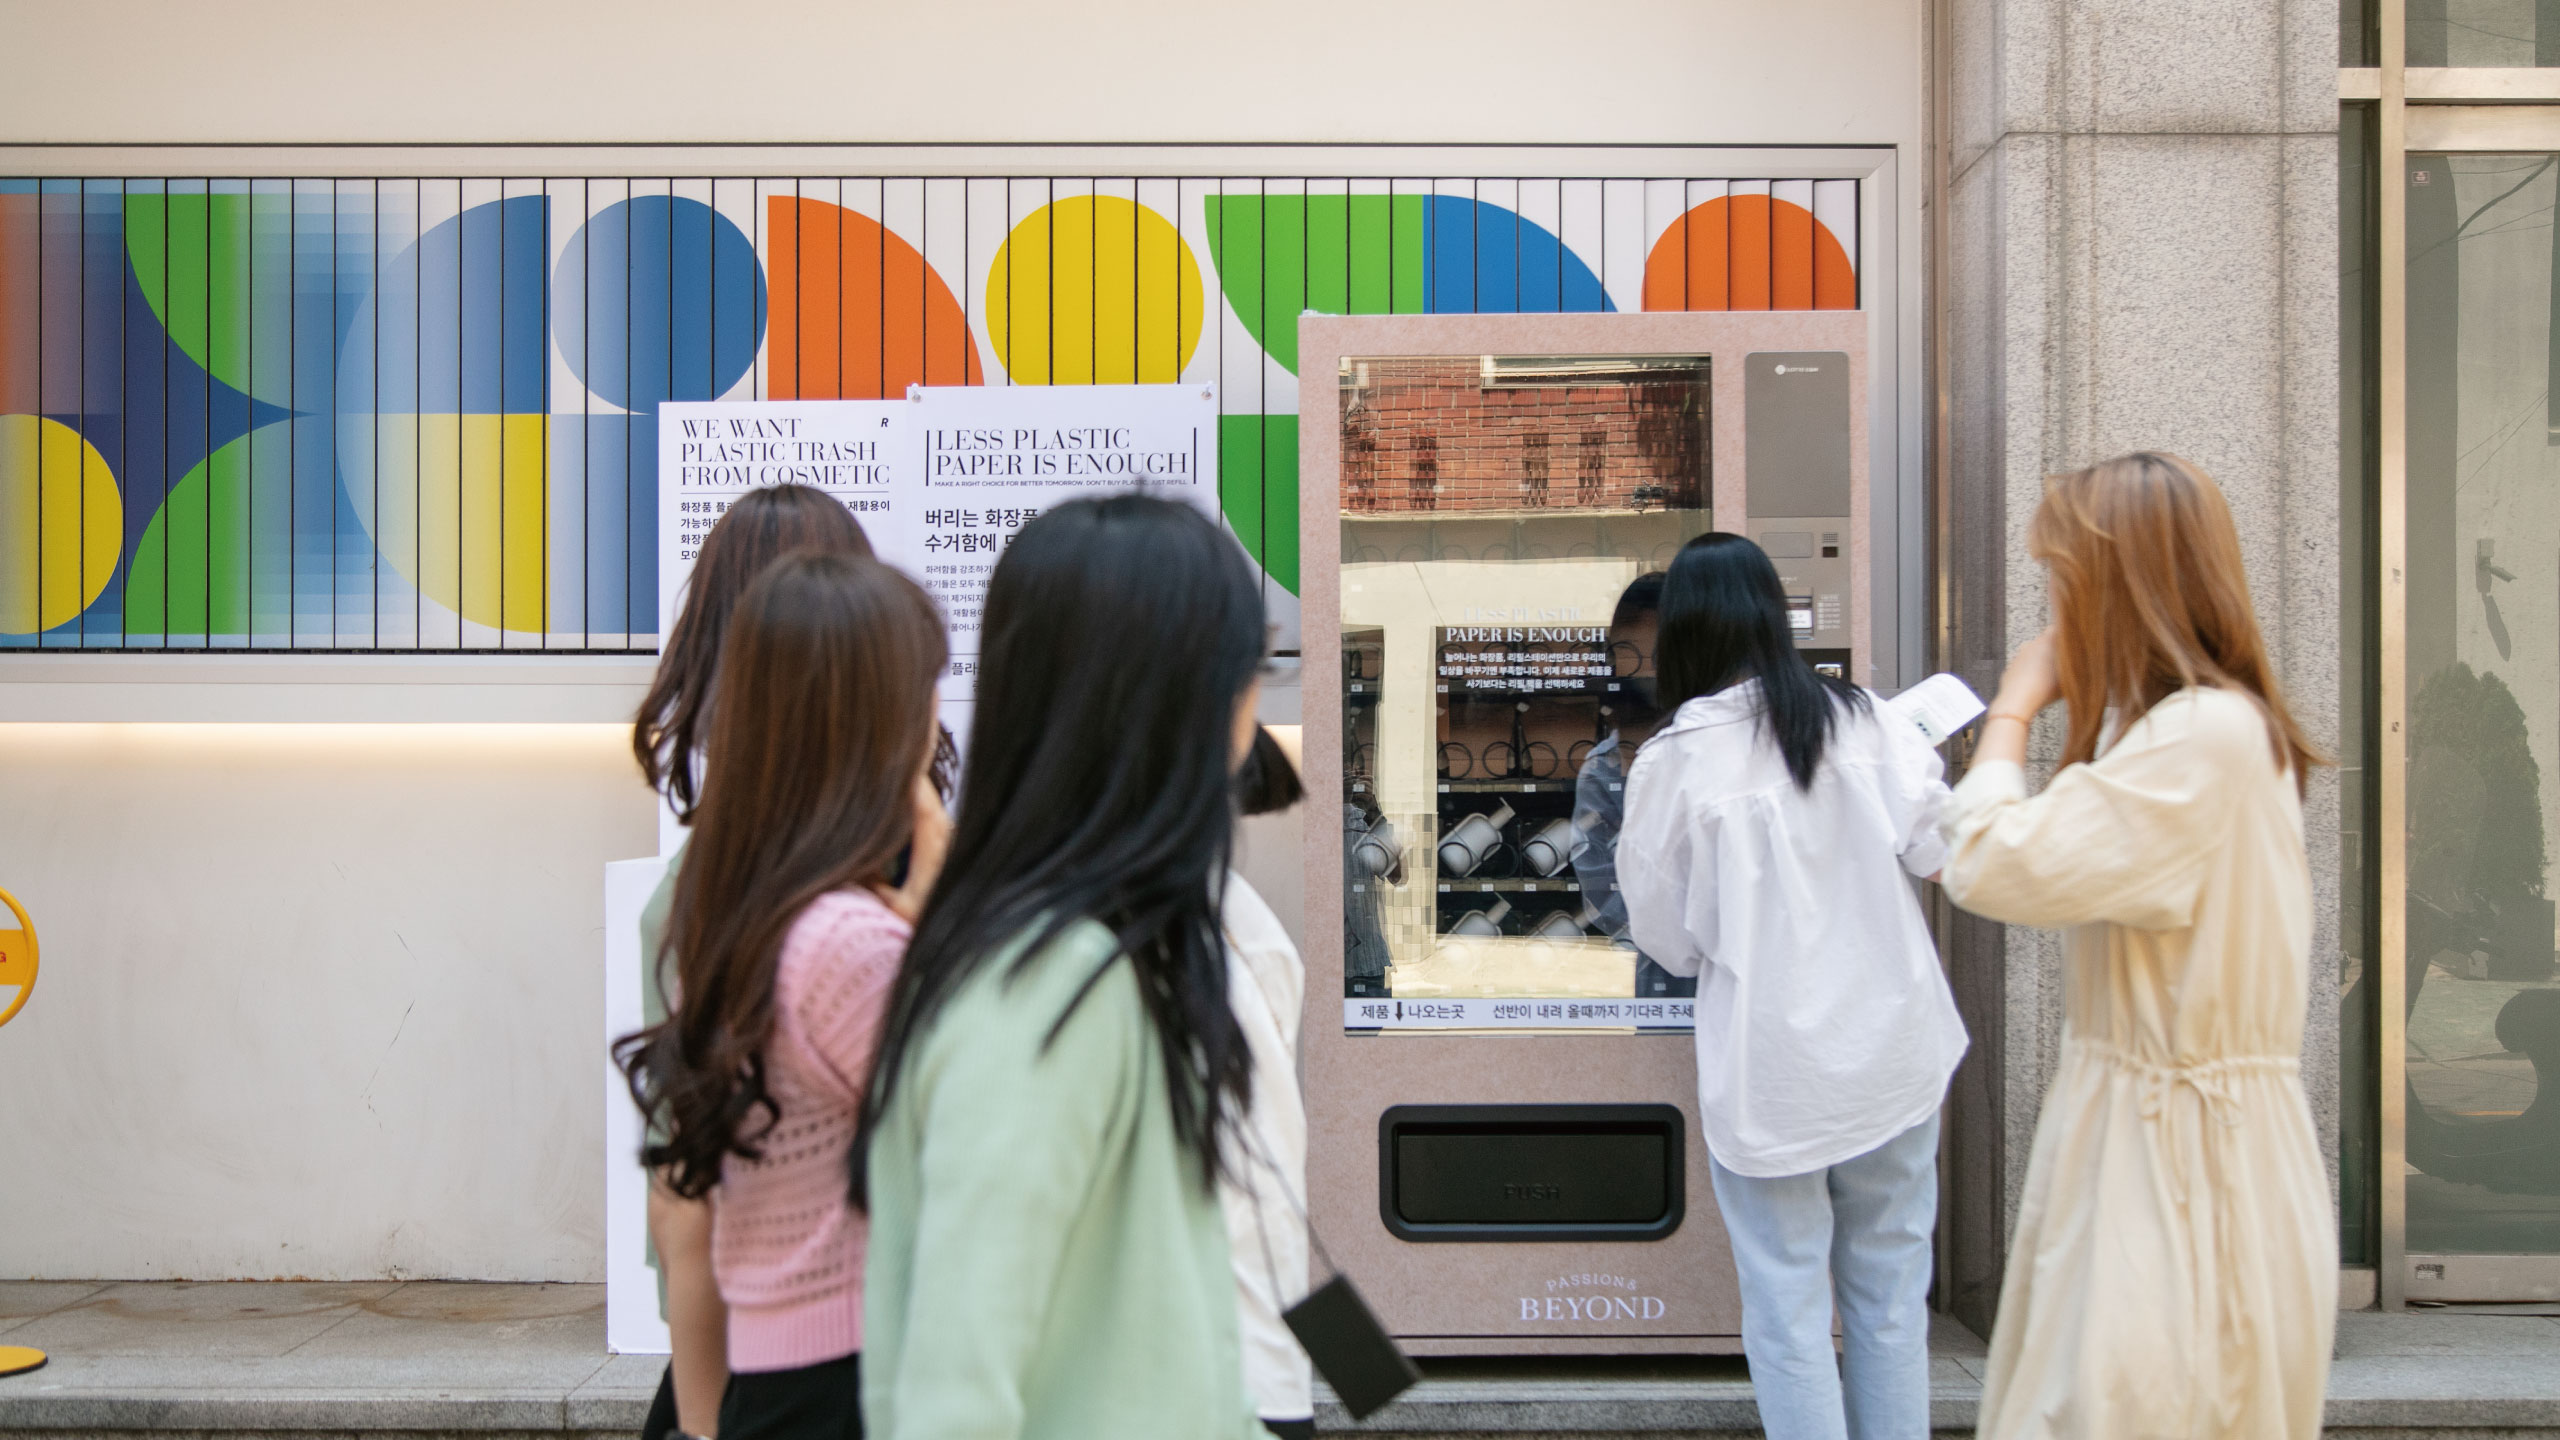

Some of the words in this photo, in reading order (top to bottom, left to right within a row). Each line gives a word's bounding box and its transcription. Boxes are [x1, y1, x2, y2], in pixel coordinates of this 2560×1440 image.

[680, 419, 721, 439] WE
[729, 418, 802, 439] WANT
[881, 417, 889, 428] R
[936, 428, 1004, 450] LESS
[1013, 428, 1130, 450] PLASTIC
[681, 442, 786, 462] PLASTIC
[792, 441, 878, 461] TRASH
[936, 454, 1024, 476] PAPER
[1033, 453, 1057, 475] IS
[1066, 452, 1188, 475] ENOUGH
[681, 466, 753, 486] FROM
[760, 464, 890, 486] COSMETIC
[680, 501, 712, 513] 화장품
[848, 500, 890, 512] 재활용이
[925, 508, 979, 528] 버리는
[925, 533, 996, 553] 수거함에
[959, 579, 976, 589] 모두
[1446, 627, 1502, 642] PAPER
[1507, 627, 1523, 642] IS
[1527, 627, 1606, 643] ENOUGH
[1361, 1004, 1389, 1020] 제품
[1408, 1004, 1465, 1020] 나오는곳
[1493, 1003, 1531, 1019] 선반이
[1537, 1003, 1562, 1019] 내려
[1567, 1003, 1620, 1020] 올때까지
[1625, 1003, 1664, 1019] 기다려
[1503, 1183, 1560, 1200] PUSH
[1519, 1295, 1666, 1321] BEYOND
